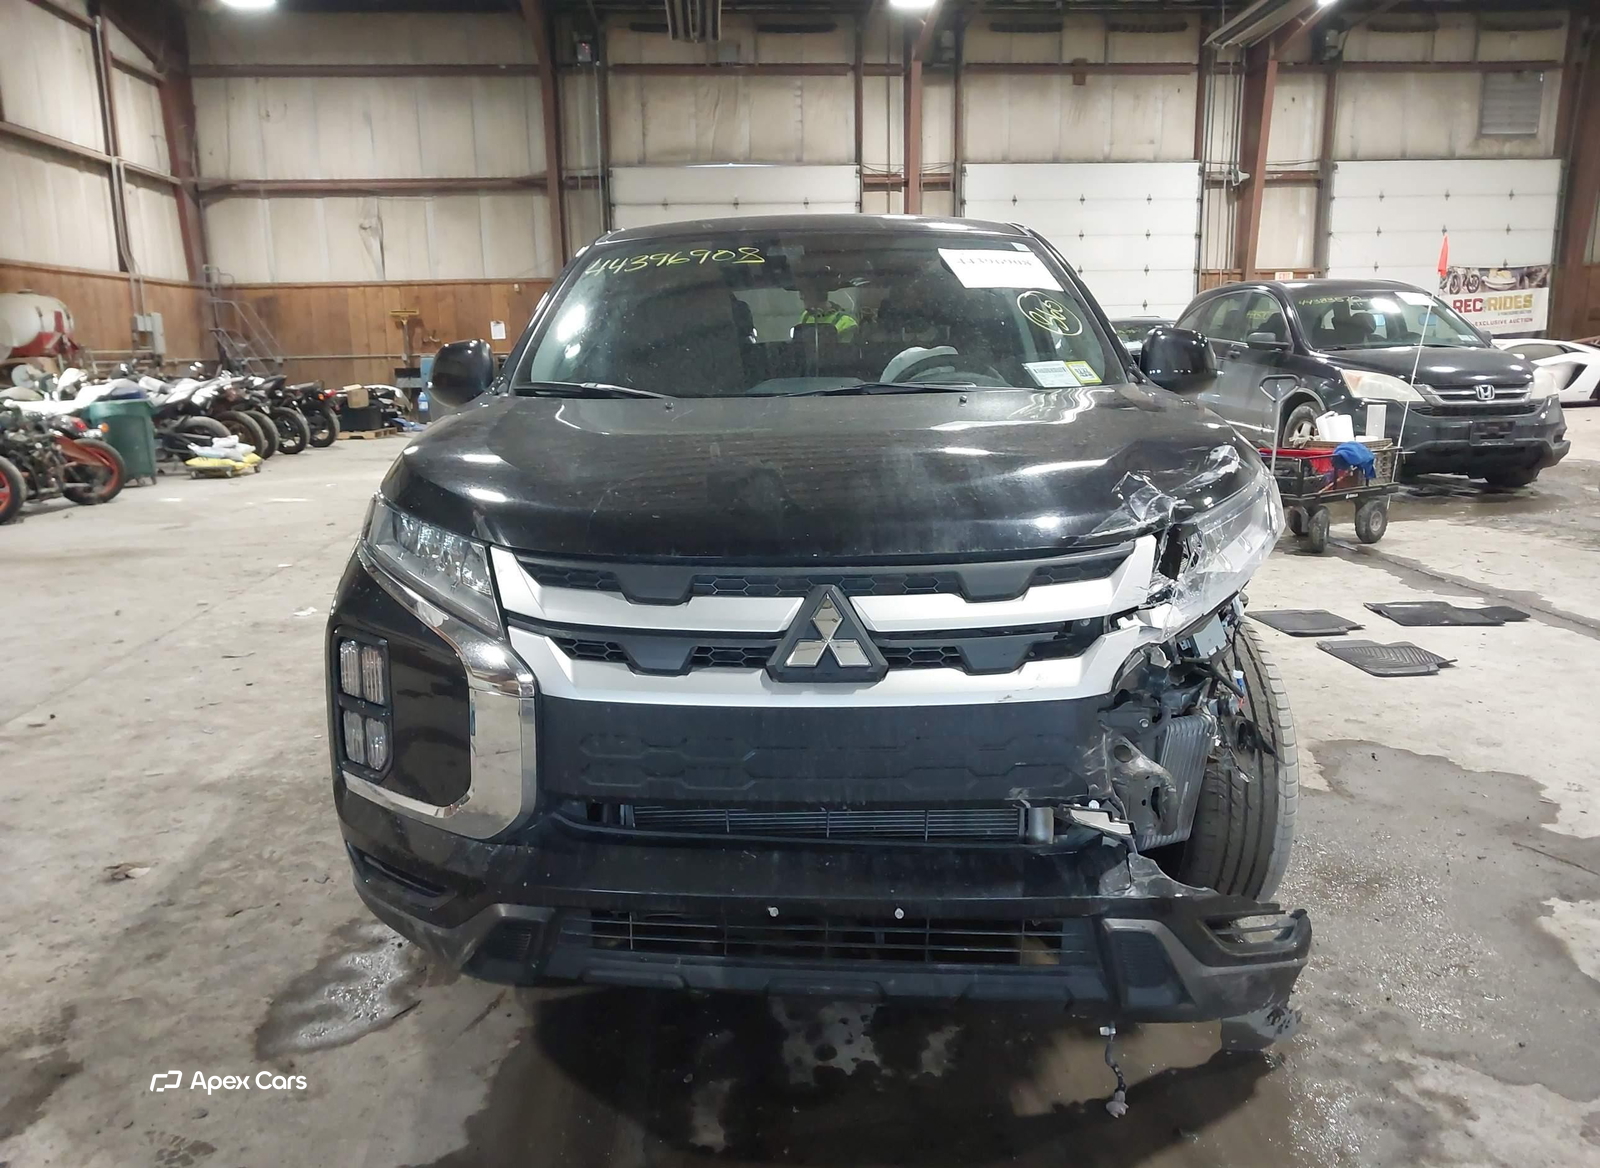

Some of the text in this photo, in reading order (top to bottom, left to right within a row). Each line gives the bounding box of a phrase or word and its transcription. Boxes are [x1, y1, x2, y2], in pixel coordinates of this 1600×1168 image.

[585, 247, 765, 276] 44396908
[1453, 298, 1484, 313] REC
[1487, 294, 1533, 312] RIDES
[1475, 319, 1507, 327] EXCLUSIVE
